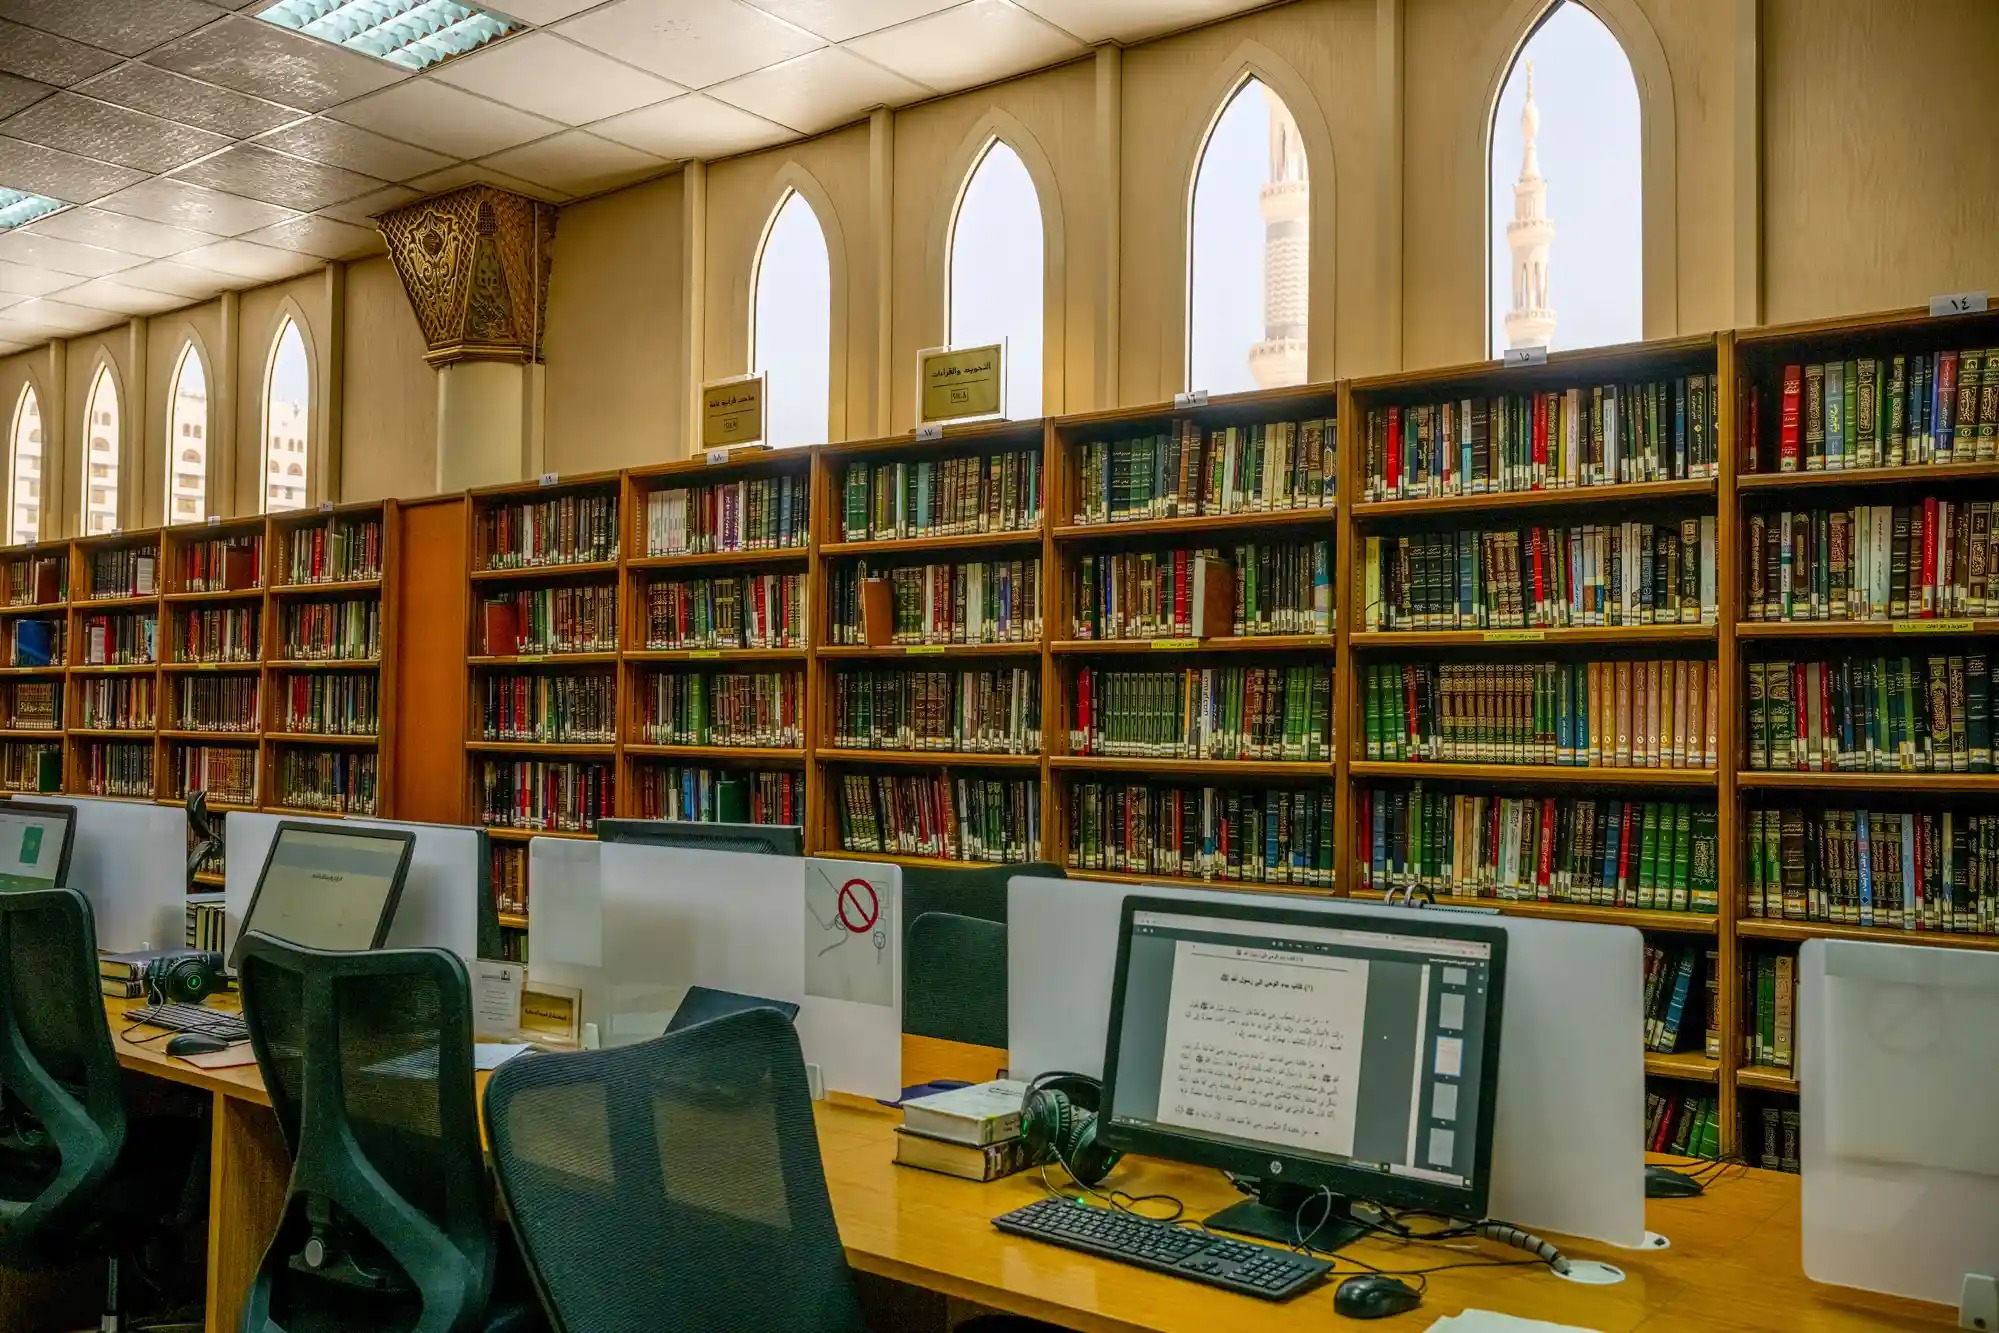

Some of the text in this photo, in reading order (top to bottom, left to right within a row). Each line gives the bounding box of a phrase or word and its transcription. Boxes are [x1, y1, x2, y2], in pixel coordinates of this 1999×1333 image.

[1951, 296, 1971, 311] ١٤
[1519, 351, 1530, 361] ١٥
[963, 361, 991, 375] التجويد
[1186, 394, 1197, 404] ١٦
[924, 428, 933, 437] ١٧
